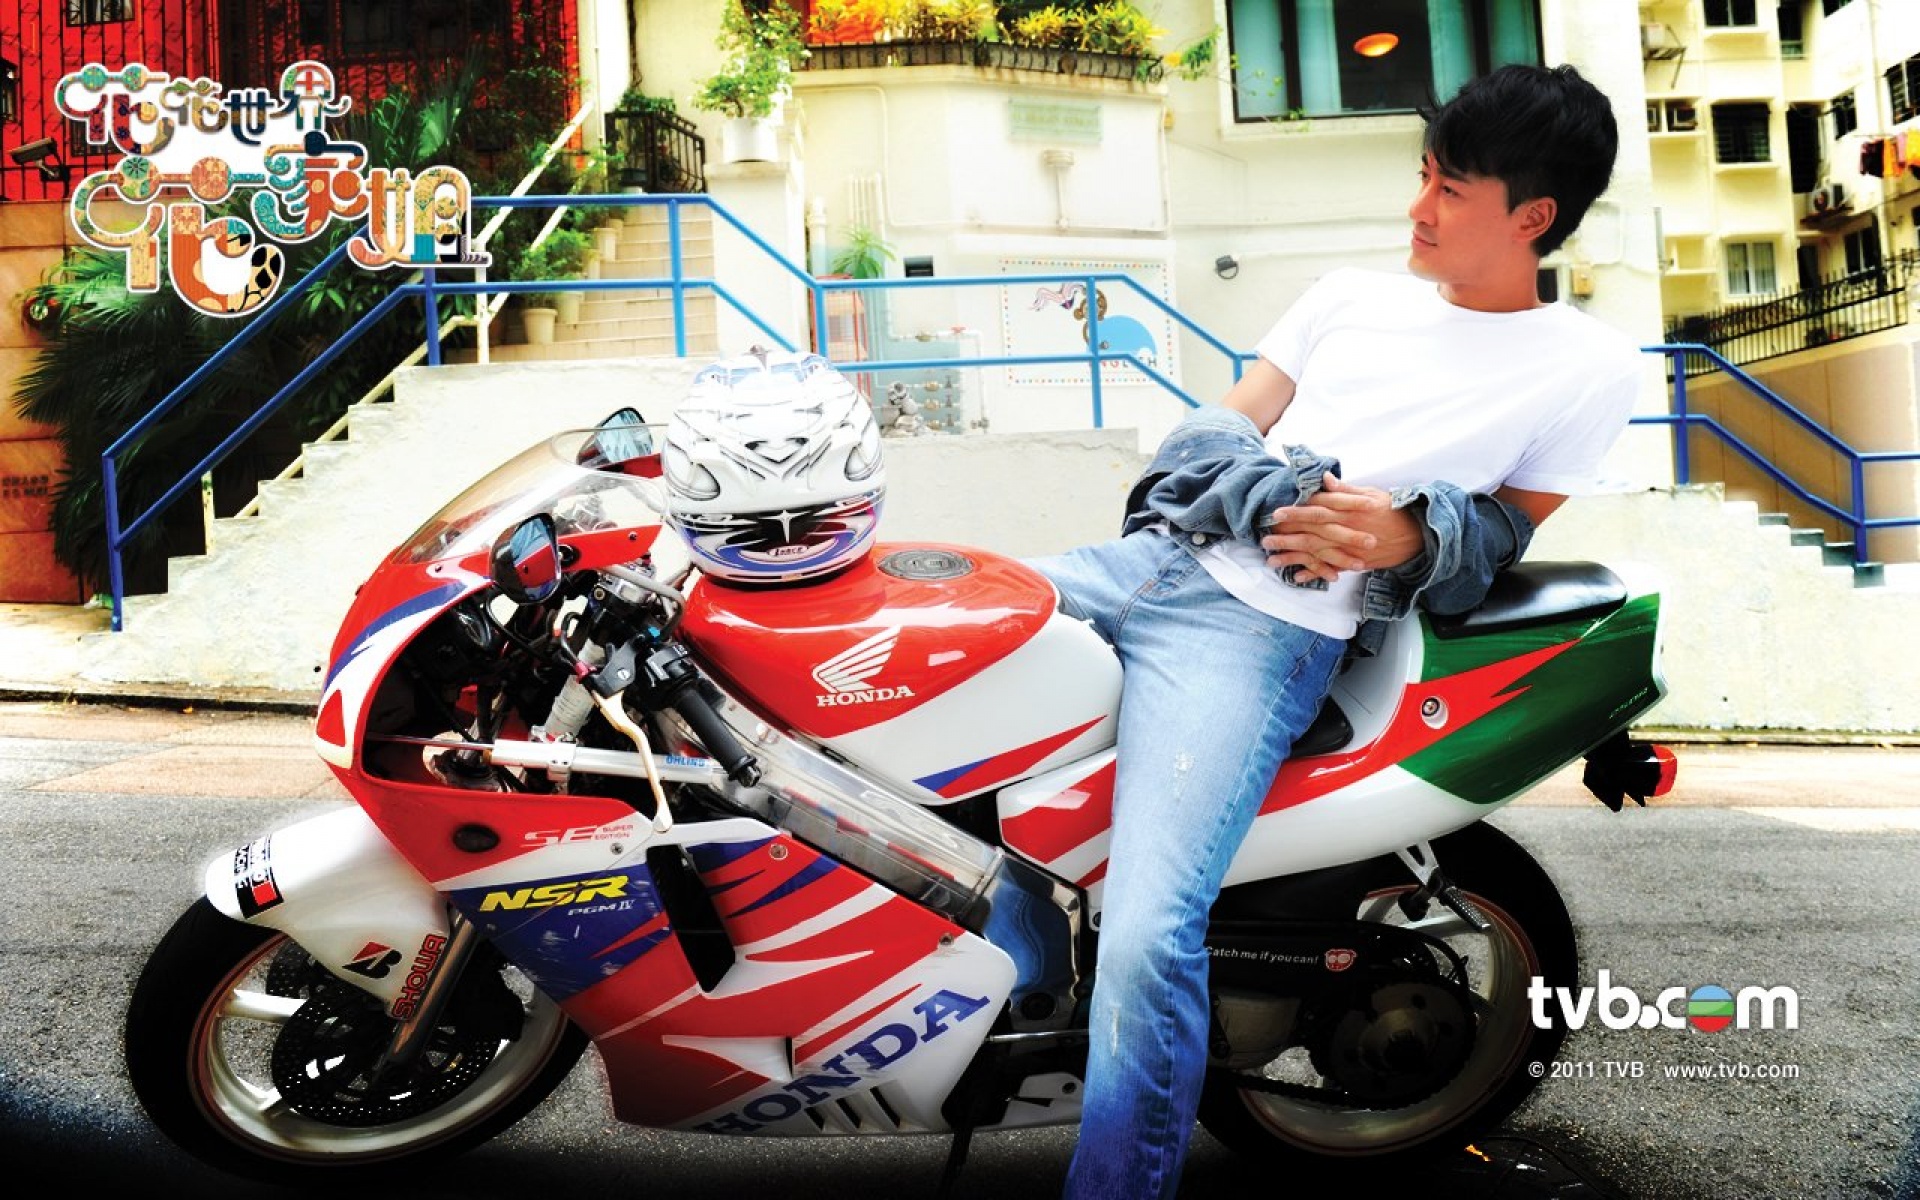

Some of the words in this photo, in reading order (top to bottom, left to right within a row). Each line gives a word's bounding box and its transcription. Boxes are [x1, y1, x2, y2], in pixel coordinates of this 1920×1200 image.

[816, 685, 915, 707] HONDA
[520, 825, 598, 846] SE
[602, 824, 634, 832] SUPER
[595, 832, 630, 841] EDITION
[479, 875, 629, 912] NSR
[567, 902, 617, 916] PGM
[1205, 946, 1238, 958] Catch
[1240, 951, 1257, 960] me
[1259, 950, 1269, 961] if
[1269, 952, 1291, 963] you
[391, 933, 448, 1023] SHOWA
[692, 989, 991, 1134] HONDA
